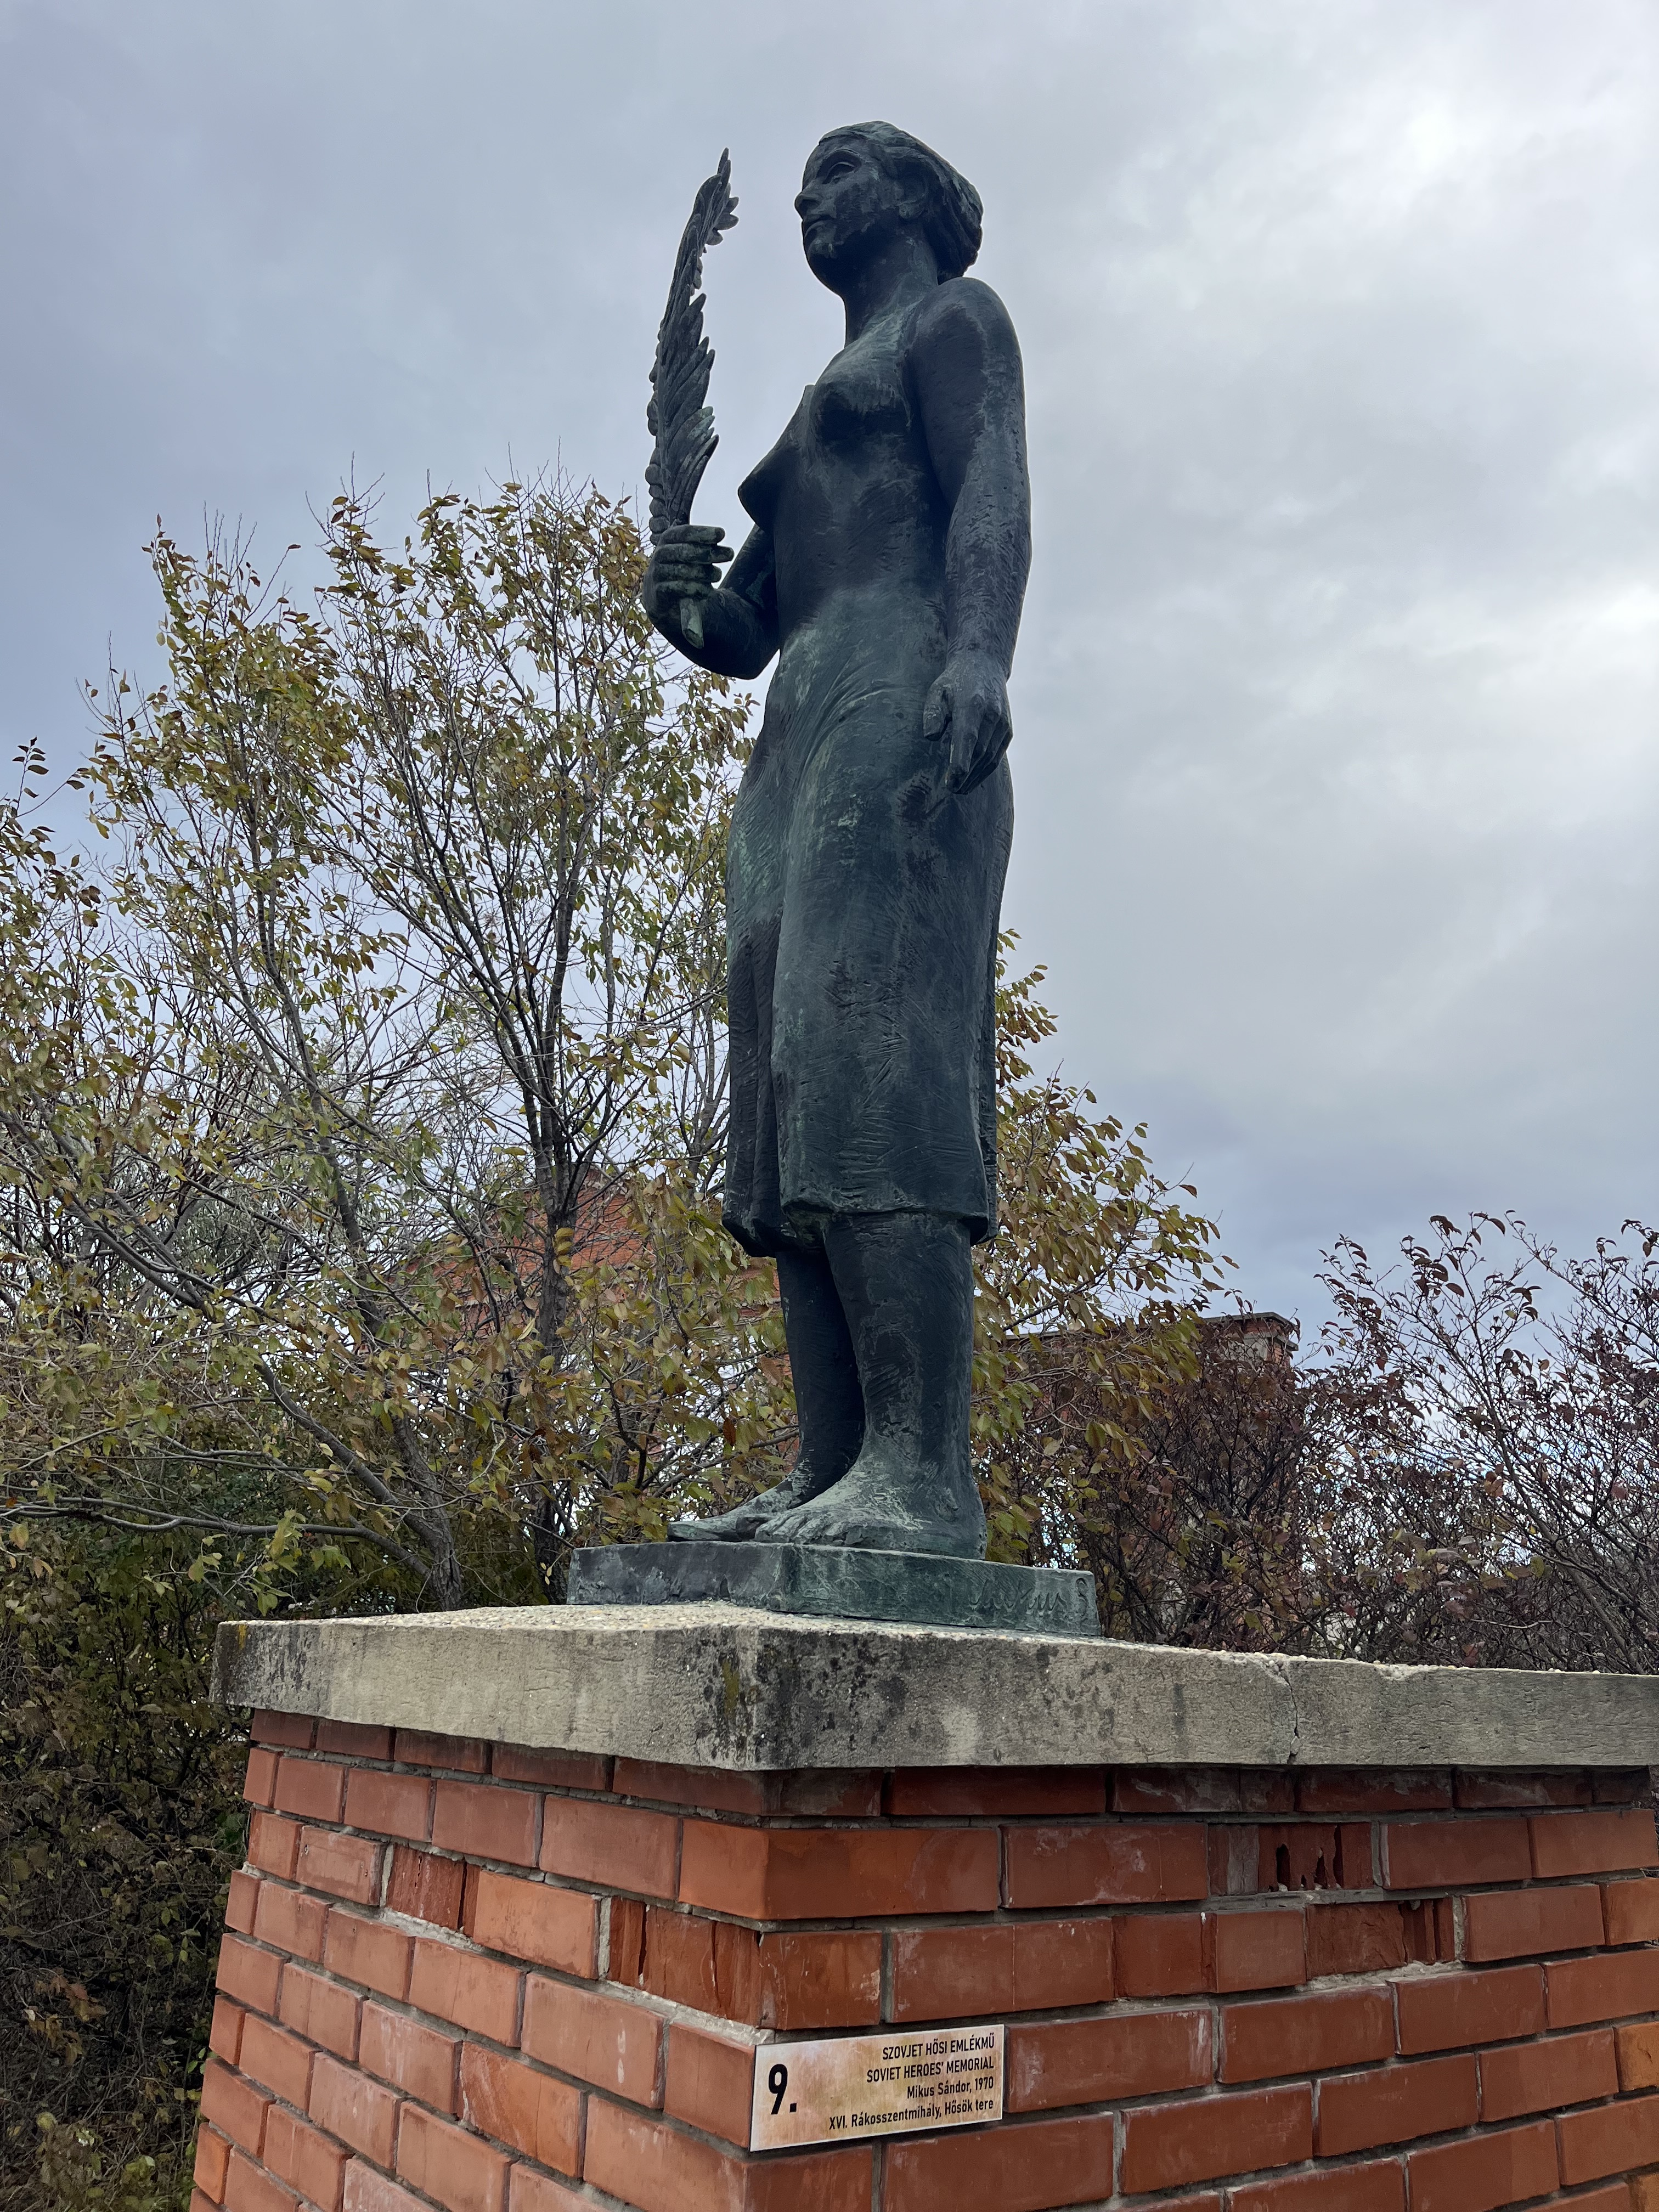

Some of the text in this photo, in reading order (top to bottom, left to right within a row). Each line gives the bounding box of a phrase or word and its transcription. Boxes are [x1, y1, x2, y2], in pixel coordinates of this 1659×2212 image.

[883, 2032, 995, 2060] SZOVJET HŐSI EMLÉKMŰ
[867, 2066, 901, 2083] SOVIET
[946, 2056, 994, 2074] MEMORIAL
[768, 2063, 797, 2115] 9.
[907, 2076, 994, 2099] Mikus Sándor, 1970
[829, 2115, 848, 2130] XVI.
[945, 2100, 973, 2115] Hősök
[975, 2099, 994, 2111] tere
